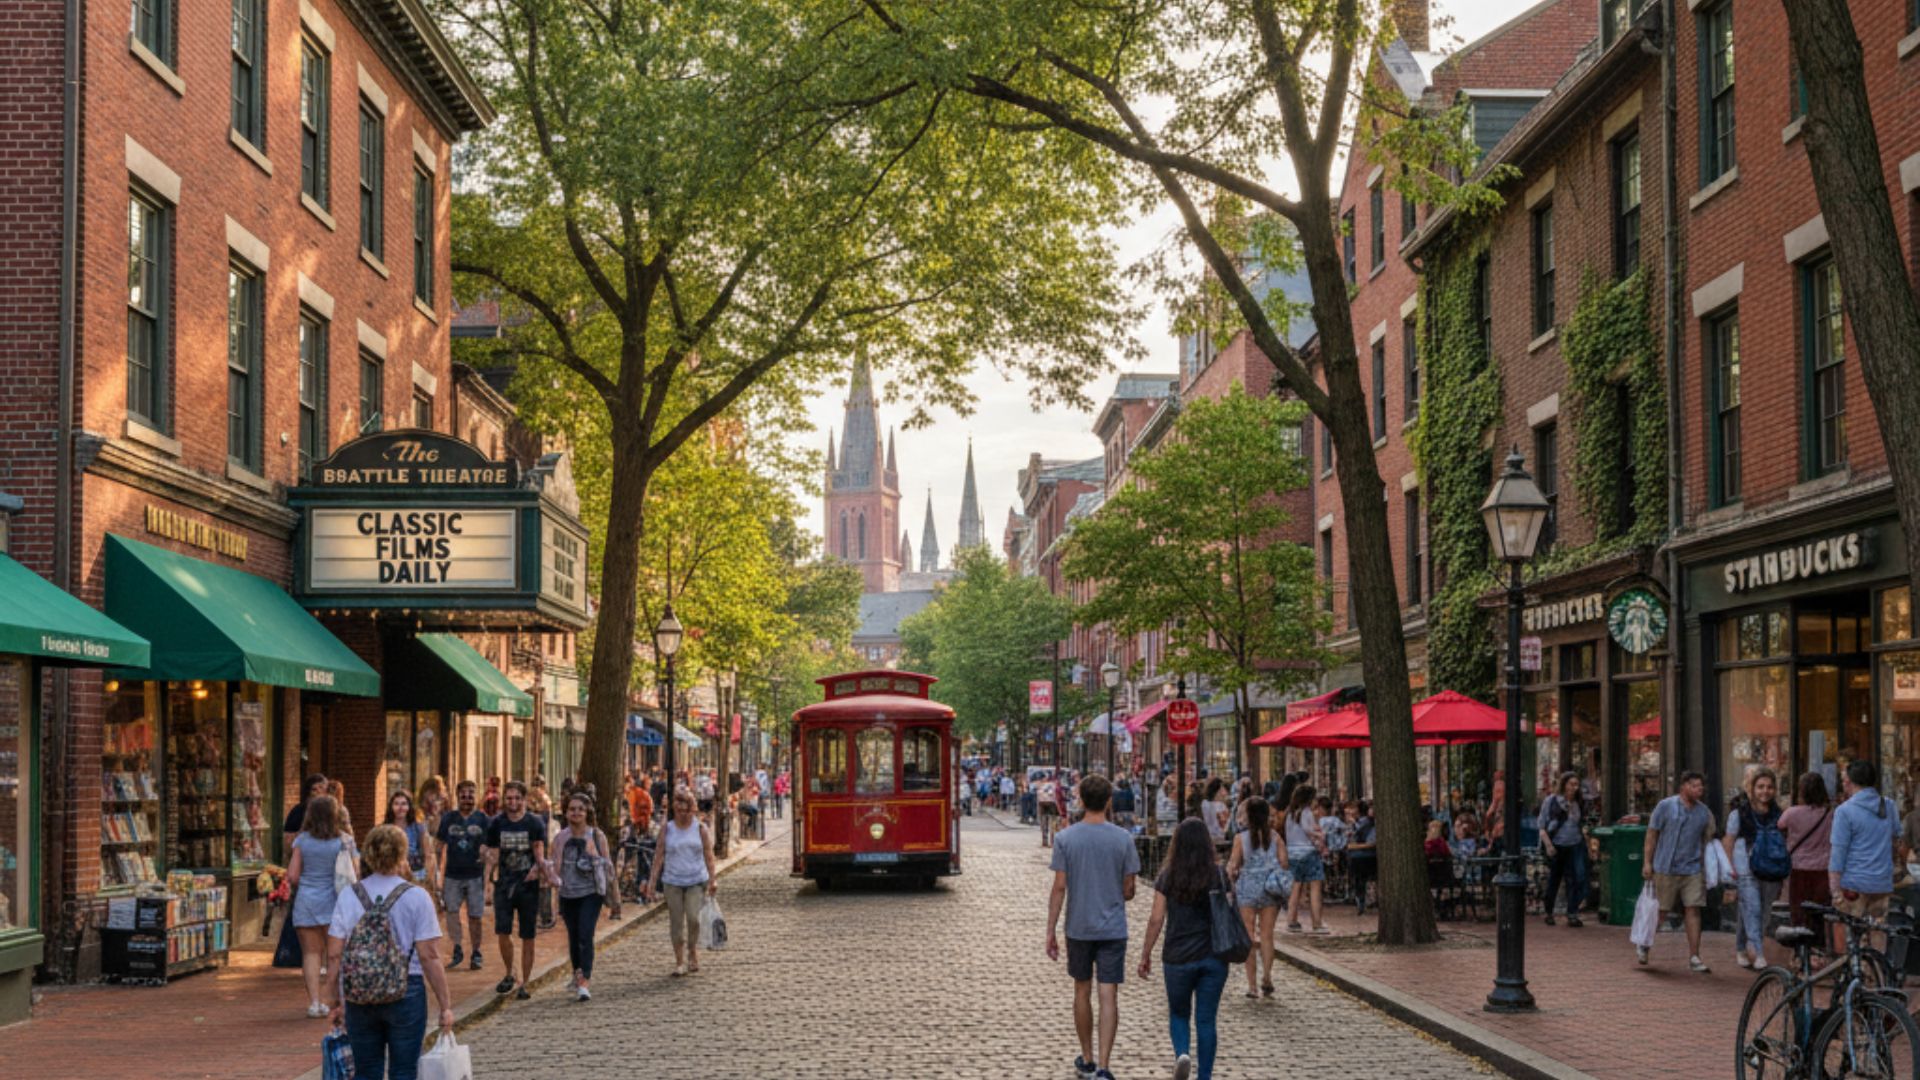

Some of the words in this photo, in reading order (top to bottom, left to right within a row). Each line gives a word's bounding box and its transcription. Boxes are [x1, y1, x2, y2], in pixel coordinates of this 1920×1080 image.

[382, 440, 440, 463] The
[357, 512, 463, 536] CLASSIC
[376, 537, 450, 560] FILMS
[379, 561, 451, 584] DAILY
[1724, 532, 1859, 593] STARBUCKS
